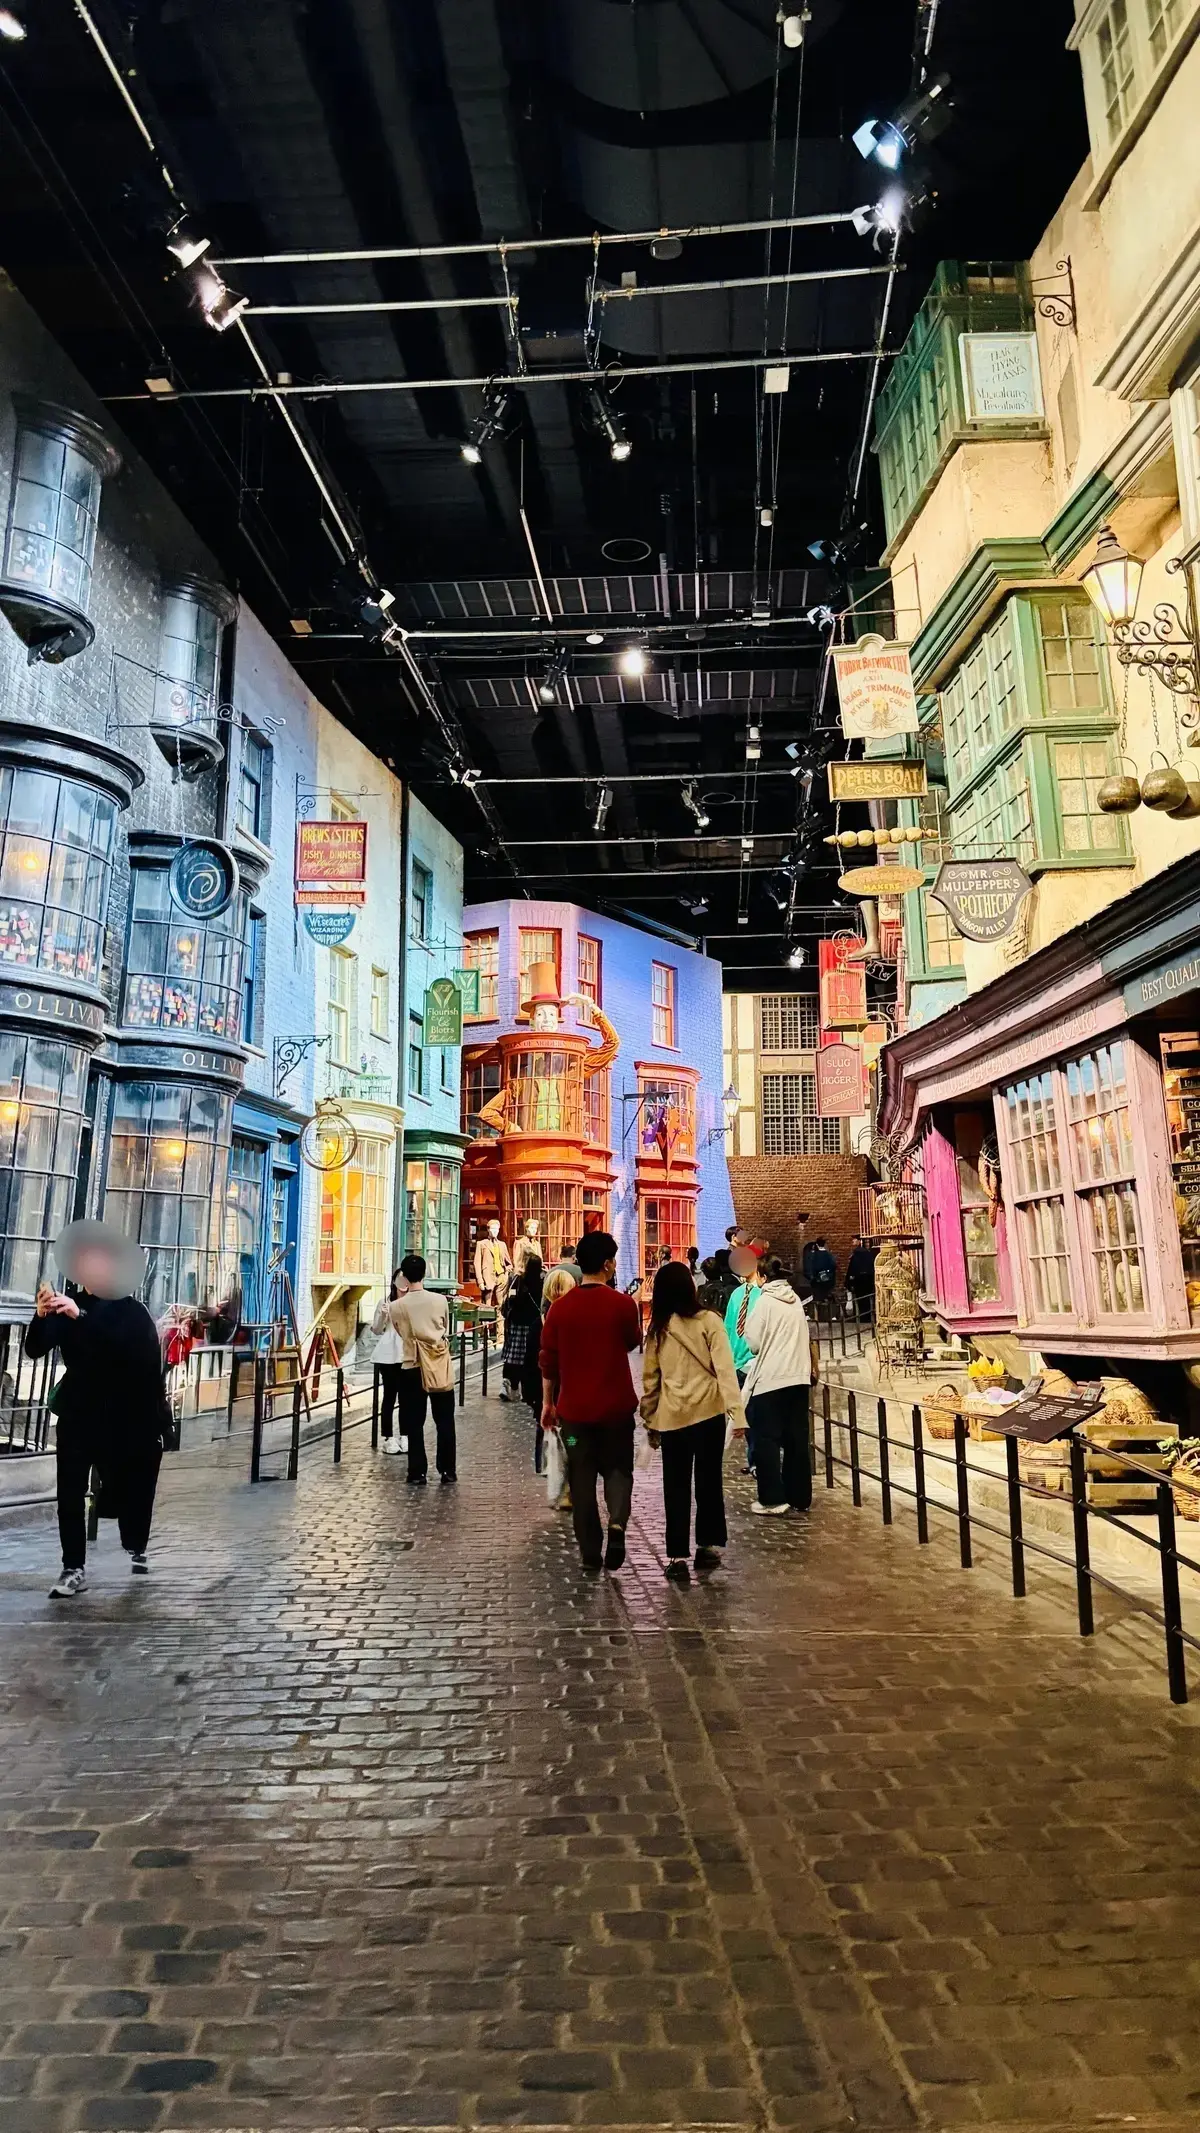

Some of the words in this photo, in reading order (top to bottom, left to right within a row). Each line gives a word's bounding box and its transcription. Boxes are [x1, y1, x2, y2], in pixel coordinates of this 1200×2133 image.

[992, 365, 1027, 384] CLASSES
[866, 683, 912, 699] TRIMMING
[889, 697, 908, 709] COST
[834, 768, 882, 795] PETER
[883, 767, 921, 793] BOAT
[302, 828, 330, 844] BREWS
[336, 828, 364, 844] STEWS
[304, 850, 324, 860] FISHY
[329, 850, 362, 860] DINNERS
[968, 869, 992, 879] MR.
[942, 878, 1021, 893] MULPEPPER'S
[959, 914, 984, 935] DIAGON
[986, 917, 1008, 936] ALLEY
[1141, 976, 1164, 1002] BEST
[15, 992, 101, 1027] OLLIVA
[427, 1008, 459, 1016] Flourish
[431, 1026, 455, 1034] Blotts
[182, 1051, 244, 1076] OLLIVA
[826, 1059, 851, 1068] SLUG
[821, 1075, 858, 1085] JIGGERS
